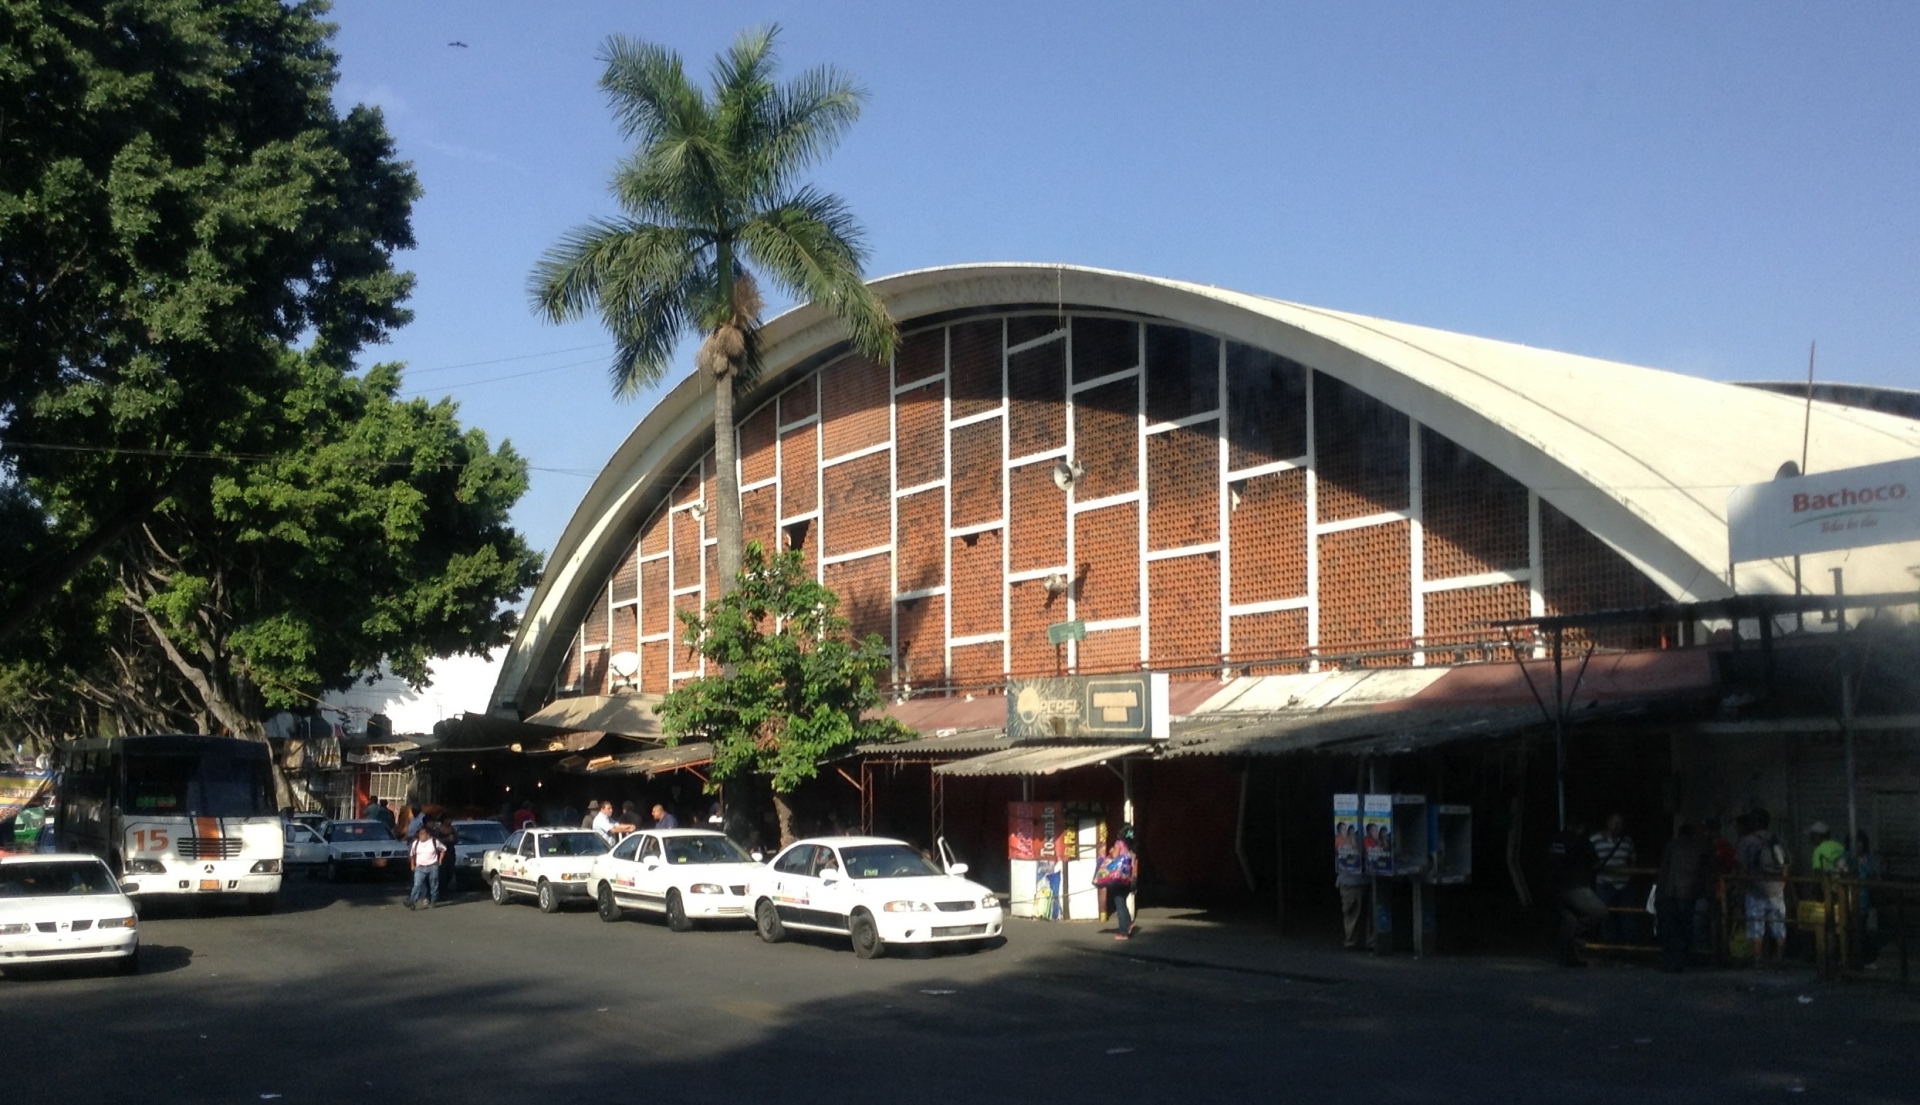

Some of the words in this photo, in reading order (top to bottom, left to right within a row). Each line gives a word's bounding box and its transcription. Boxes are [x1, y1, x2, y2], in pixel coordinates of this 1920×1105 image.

[1792, 483, 1906, 513] Bachoco
[132, 829, 169, 852] 15
[1040, 807, 1055, 857] Tocando
